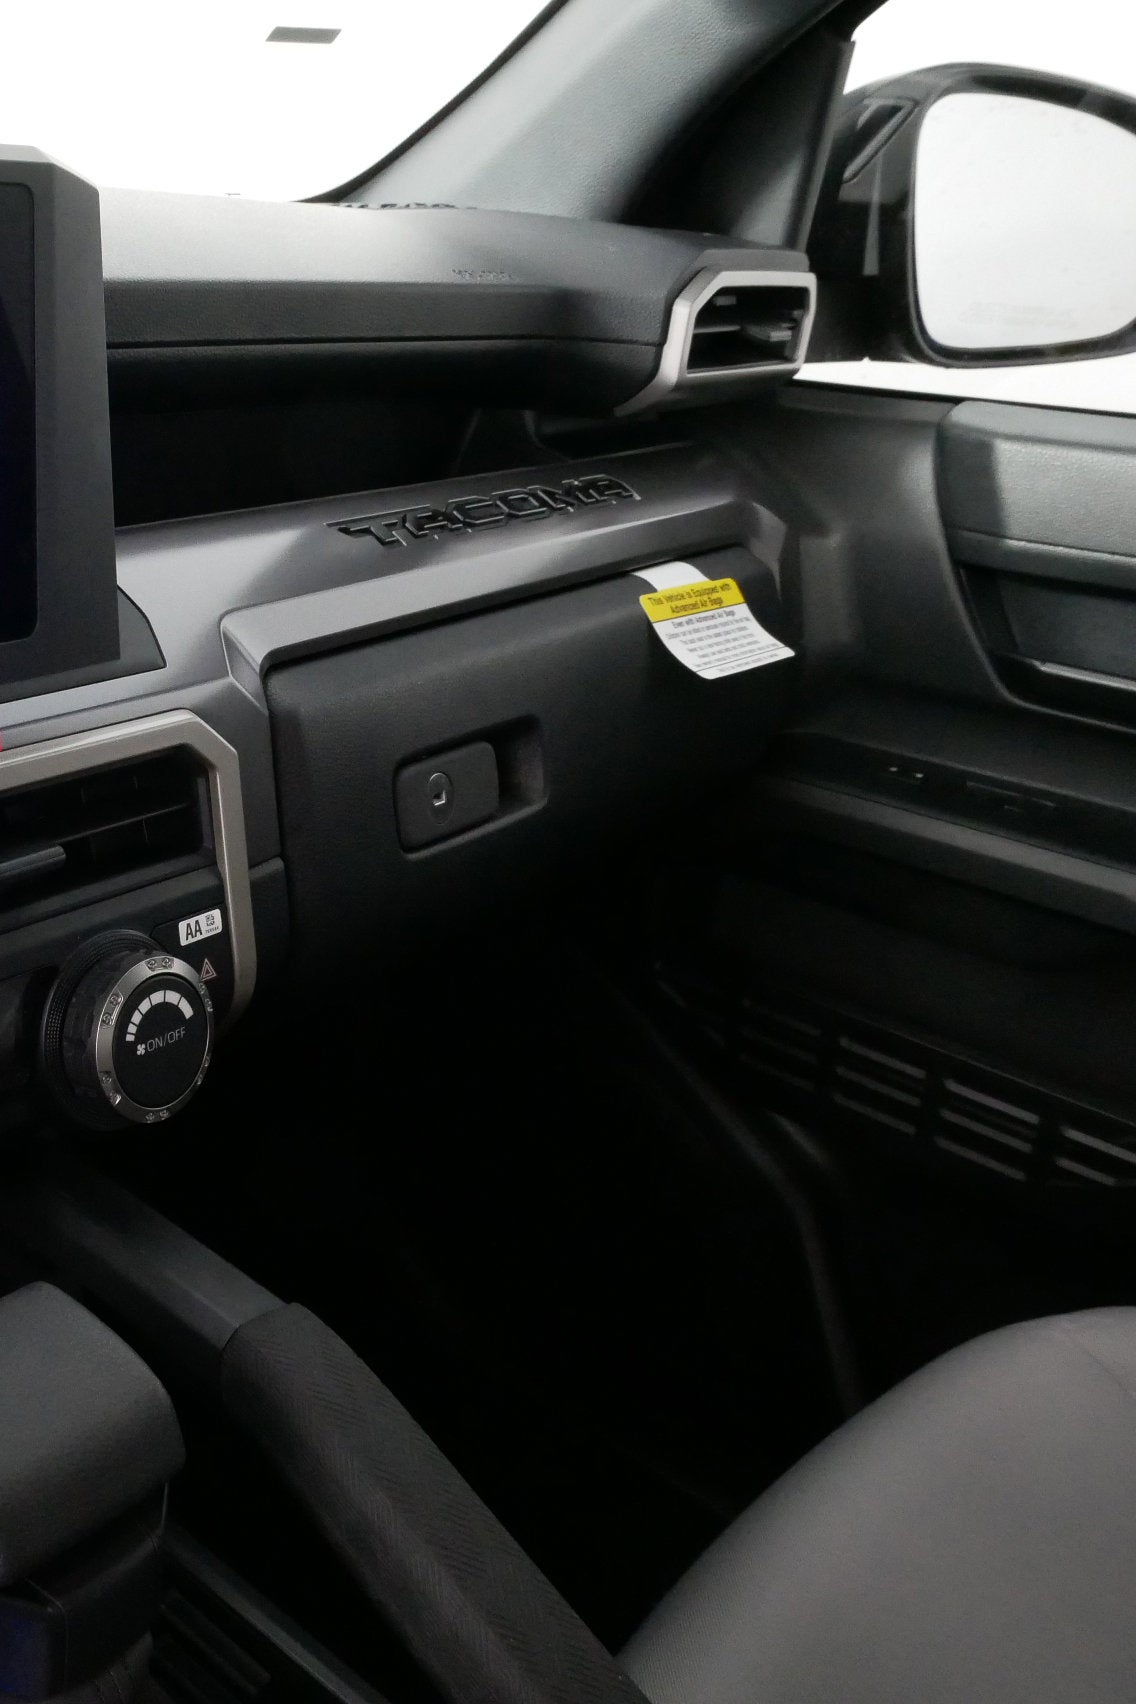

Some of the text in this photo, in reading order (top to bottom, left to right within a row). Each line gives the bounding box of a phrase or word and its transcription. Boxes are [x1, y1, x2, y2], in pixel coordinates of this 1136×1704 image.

[323, 474, 642, 546] TACOMA
[185, 919, 203, 941] AA
[147, 1027, 186, 1052] ON/OFF
